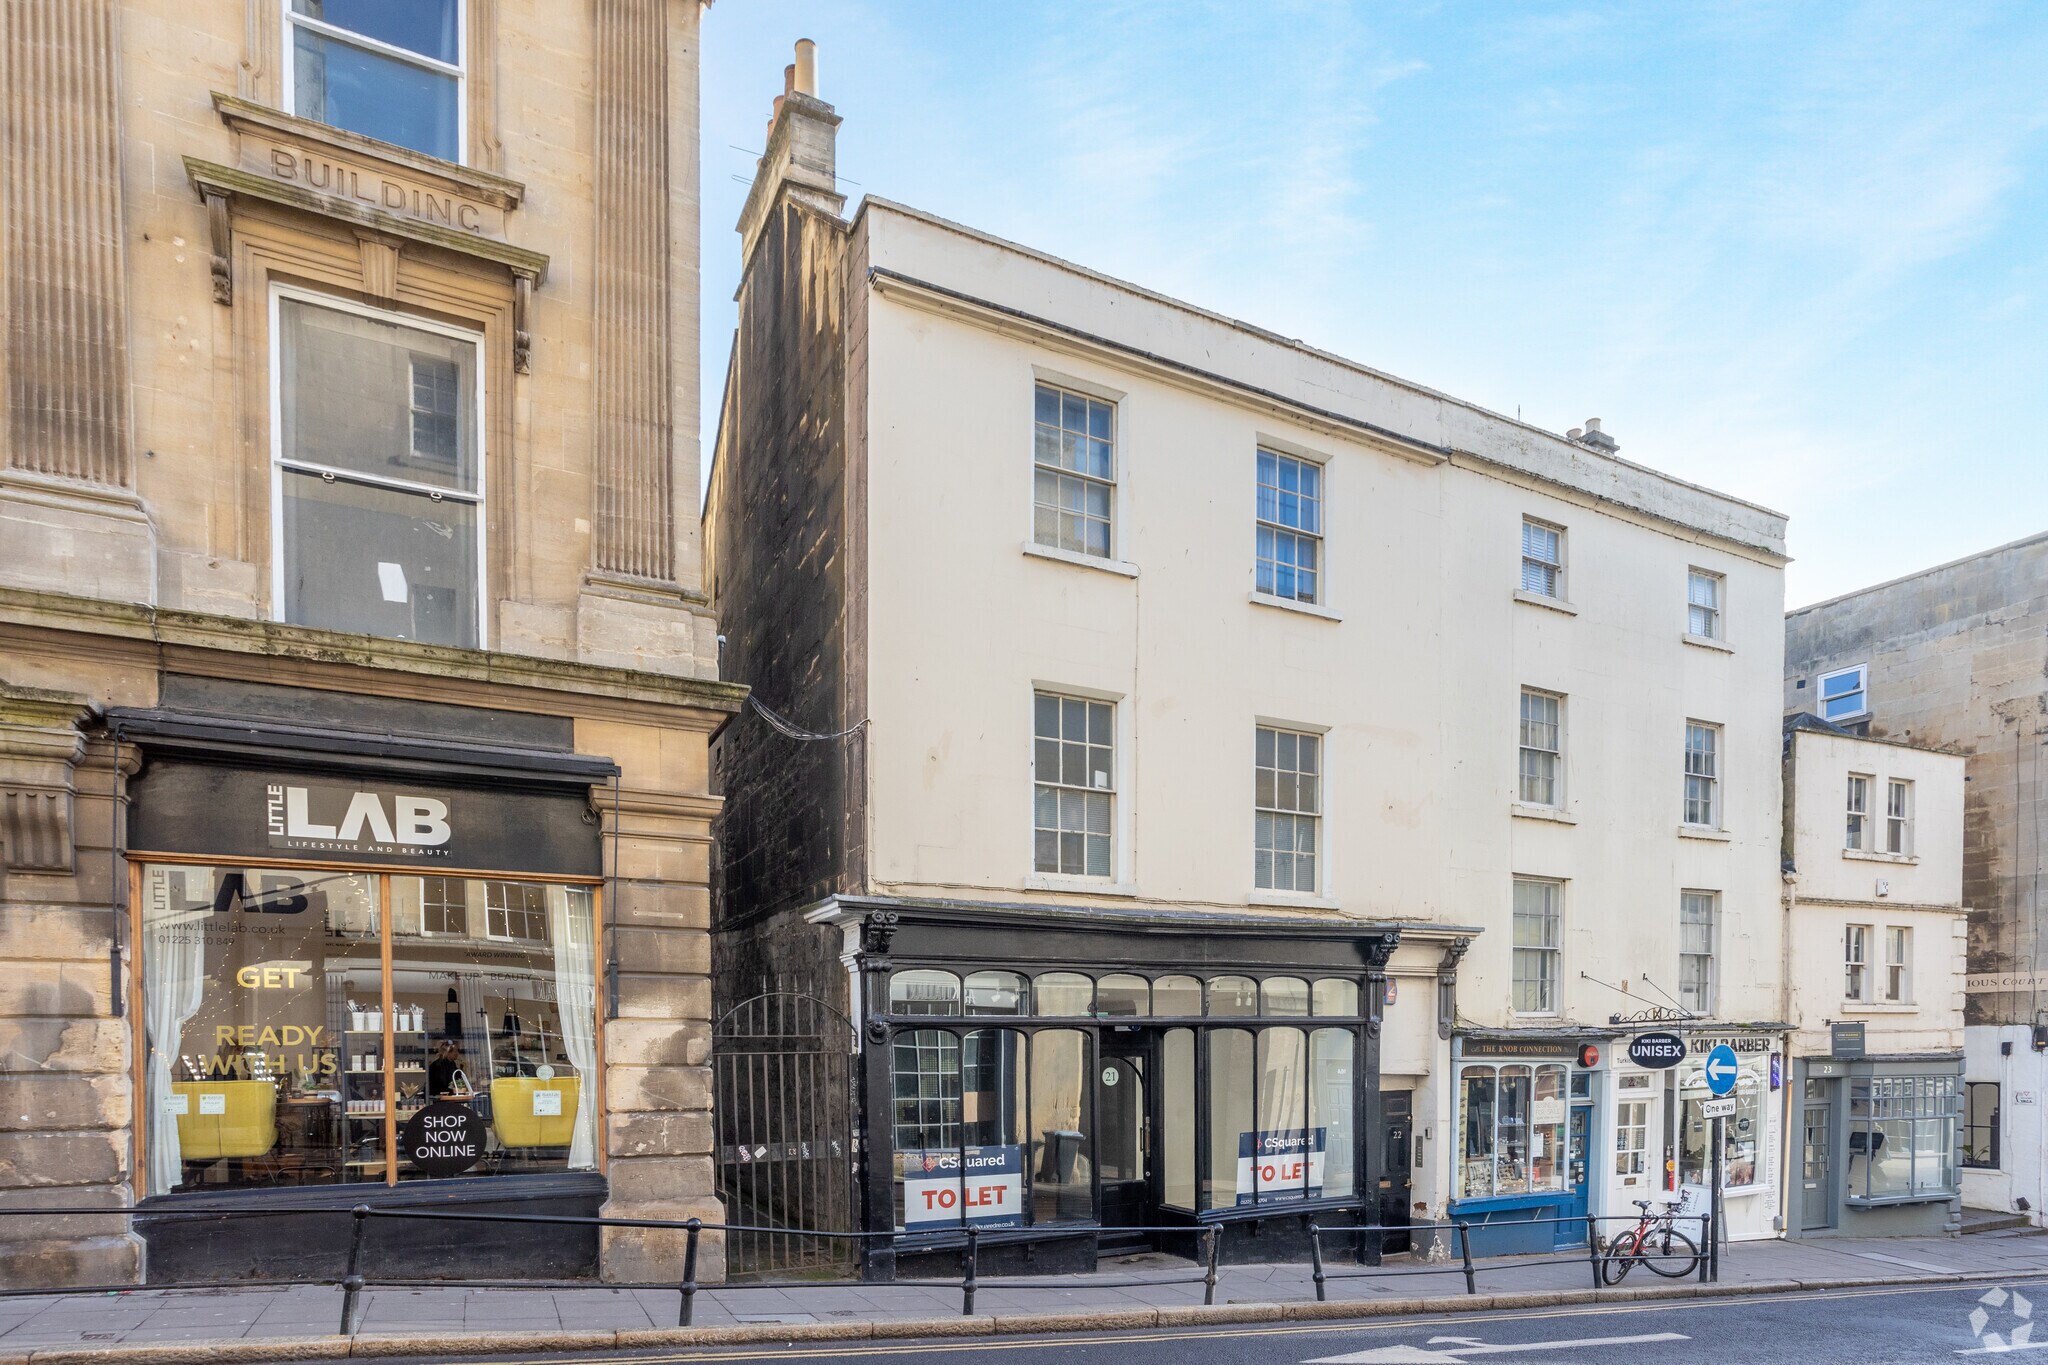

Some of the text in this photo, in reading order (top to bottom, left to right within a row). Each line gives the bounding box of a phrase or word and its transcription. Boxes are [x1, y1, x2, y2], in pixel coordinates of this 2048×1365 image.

[271, 149, 480, 233] BUILDING
[268, 785, 284, 836] LITTLE
[287, 787, 451, 845] LAB
[288, 840, 358, 851] LIFESTYLE
[402, 847, 449, 856] BEAUTY
[152, 869, 165, 910] LITTLE
[168, 871, 308, 914] LAB
[158, 920, 286, 934] www.littlelab.co.uk
[158, 935, 235, 946] 01225 310 849
[237, 967, 301, 989] GET
[428, 971, 533, 981] MAKE UP BEAUTY
[216, 1025, 324, 1046] READY
[1482, 1045, 1563, 1053] THE KNOB CONNECTION
[1632, 1045, 1682, 1057] UNISEX
[1691, 1038, 1717, 1053] KIKI
[201, 1053, 337, 1075] WITH US
[1823, 1065, 1832, 1073] 23
[1105, 1071, 1115, 1081] 21
[1705, 1103, 1734, 1113] One way
[424, 1115, 467, 1128] SHOP
[425, 1130, 467, 1143] NOW
[1393, 1131, 1402, 1139] 22
[416, 1145, 476, 1159] ONLINE
[922, 1185, 1007, 1210] TO LET
